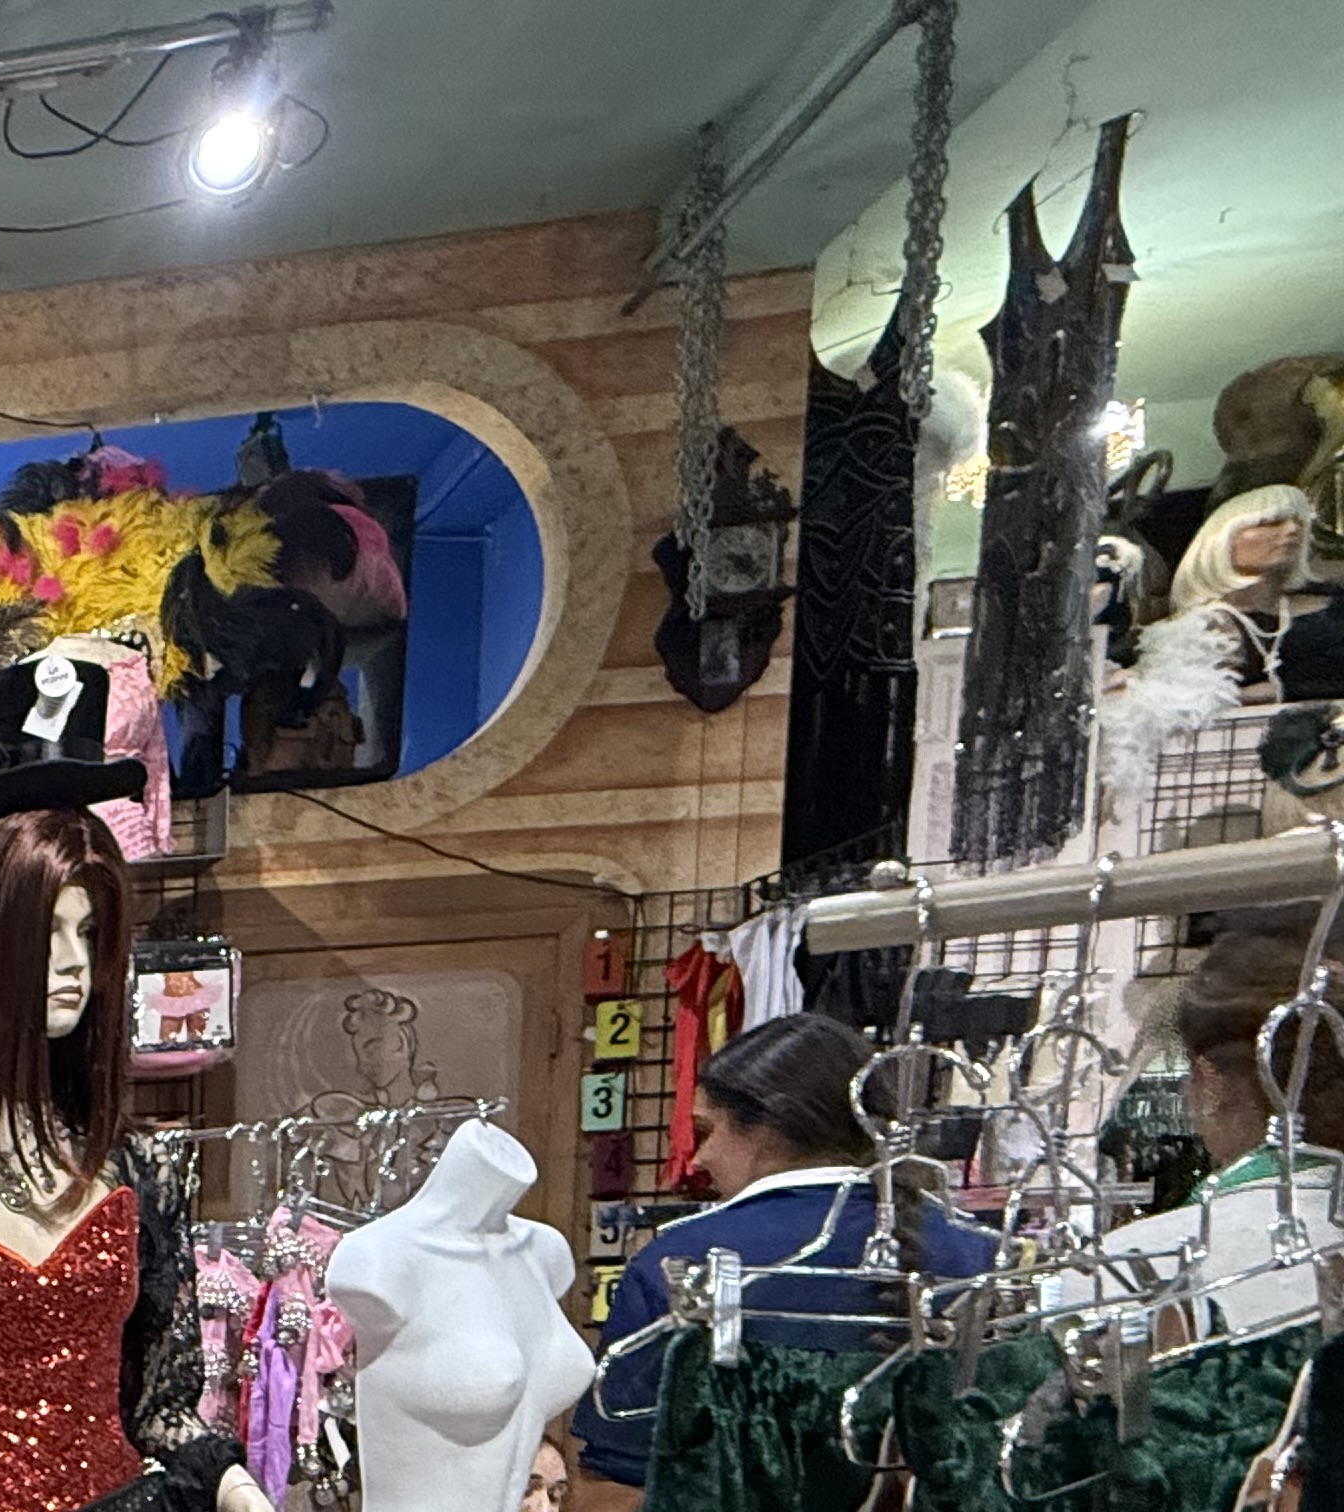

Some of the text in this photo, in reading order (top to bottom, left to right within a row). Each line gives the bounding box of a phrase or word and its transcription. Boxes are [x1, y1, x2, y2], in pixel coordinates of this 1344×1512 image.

[597, 950, 611, 980] 1
[609, 1012, 630, 1045] 2
[592, 1087, 613, 1118] 3
[605, 1146, 624, 1177] 4
